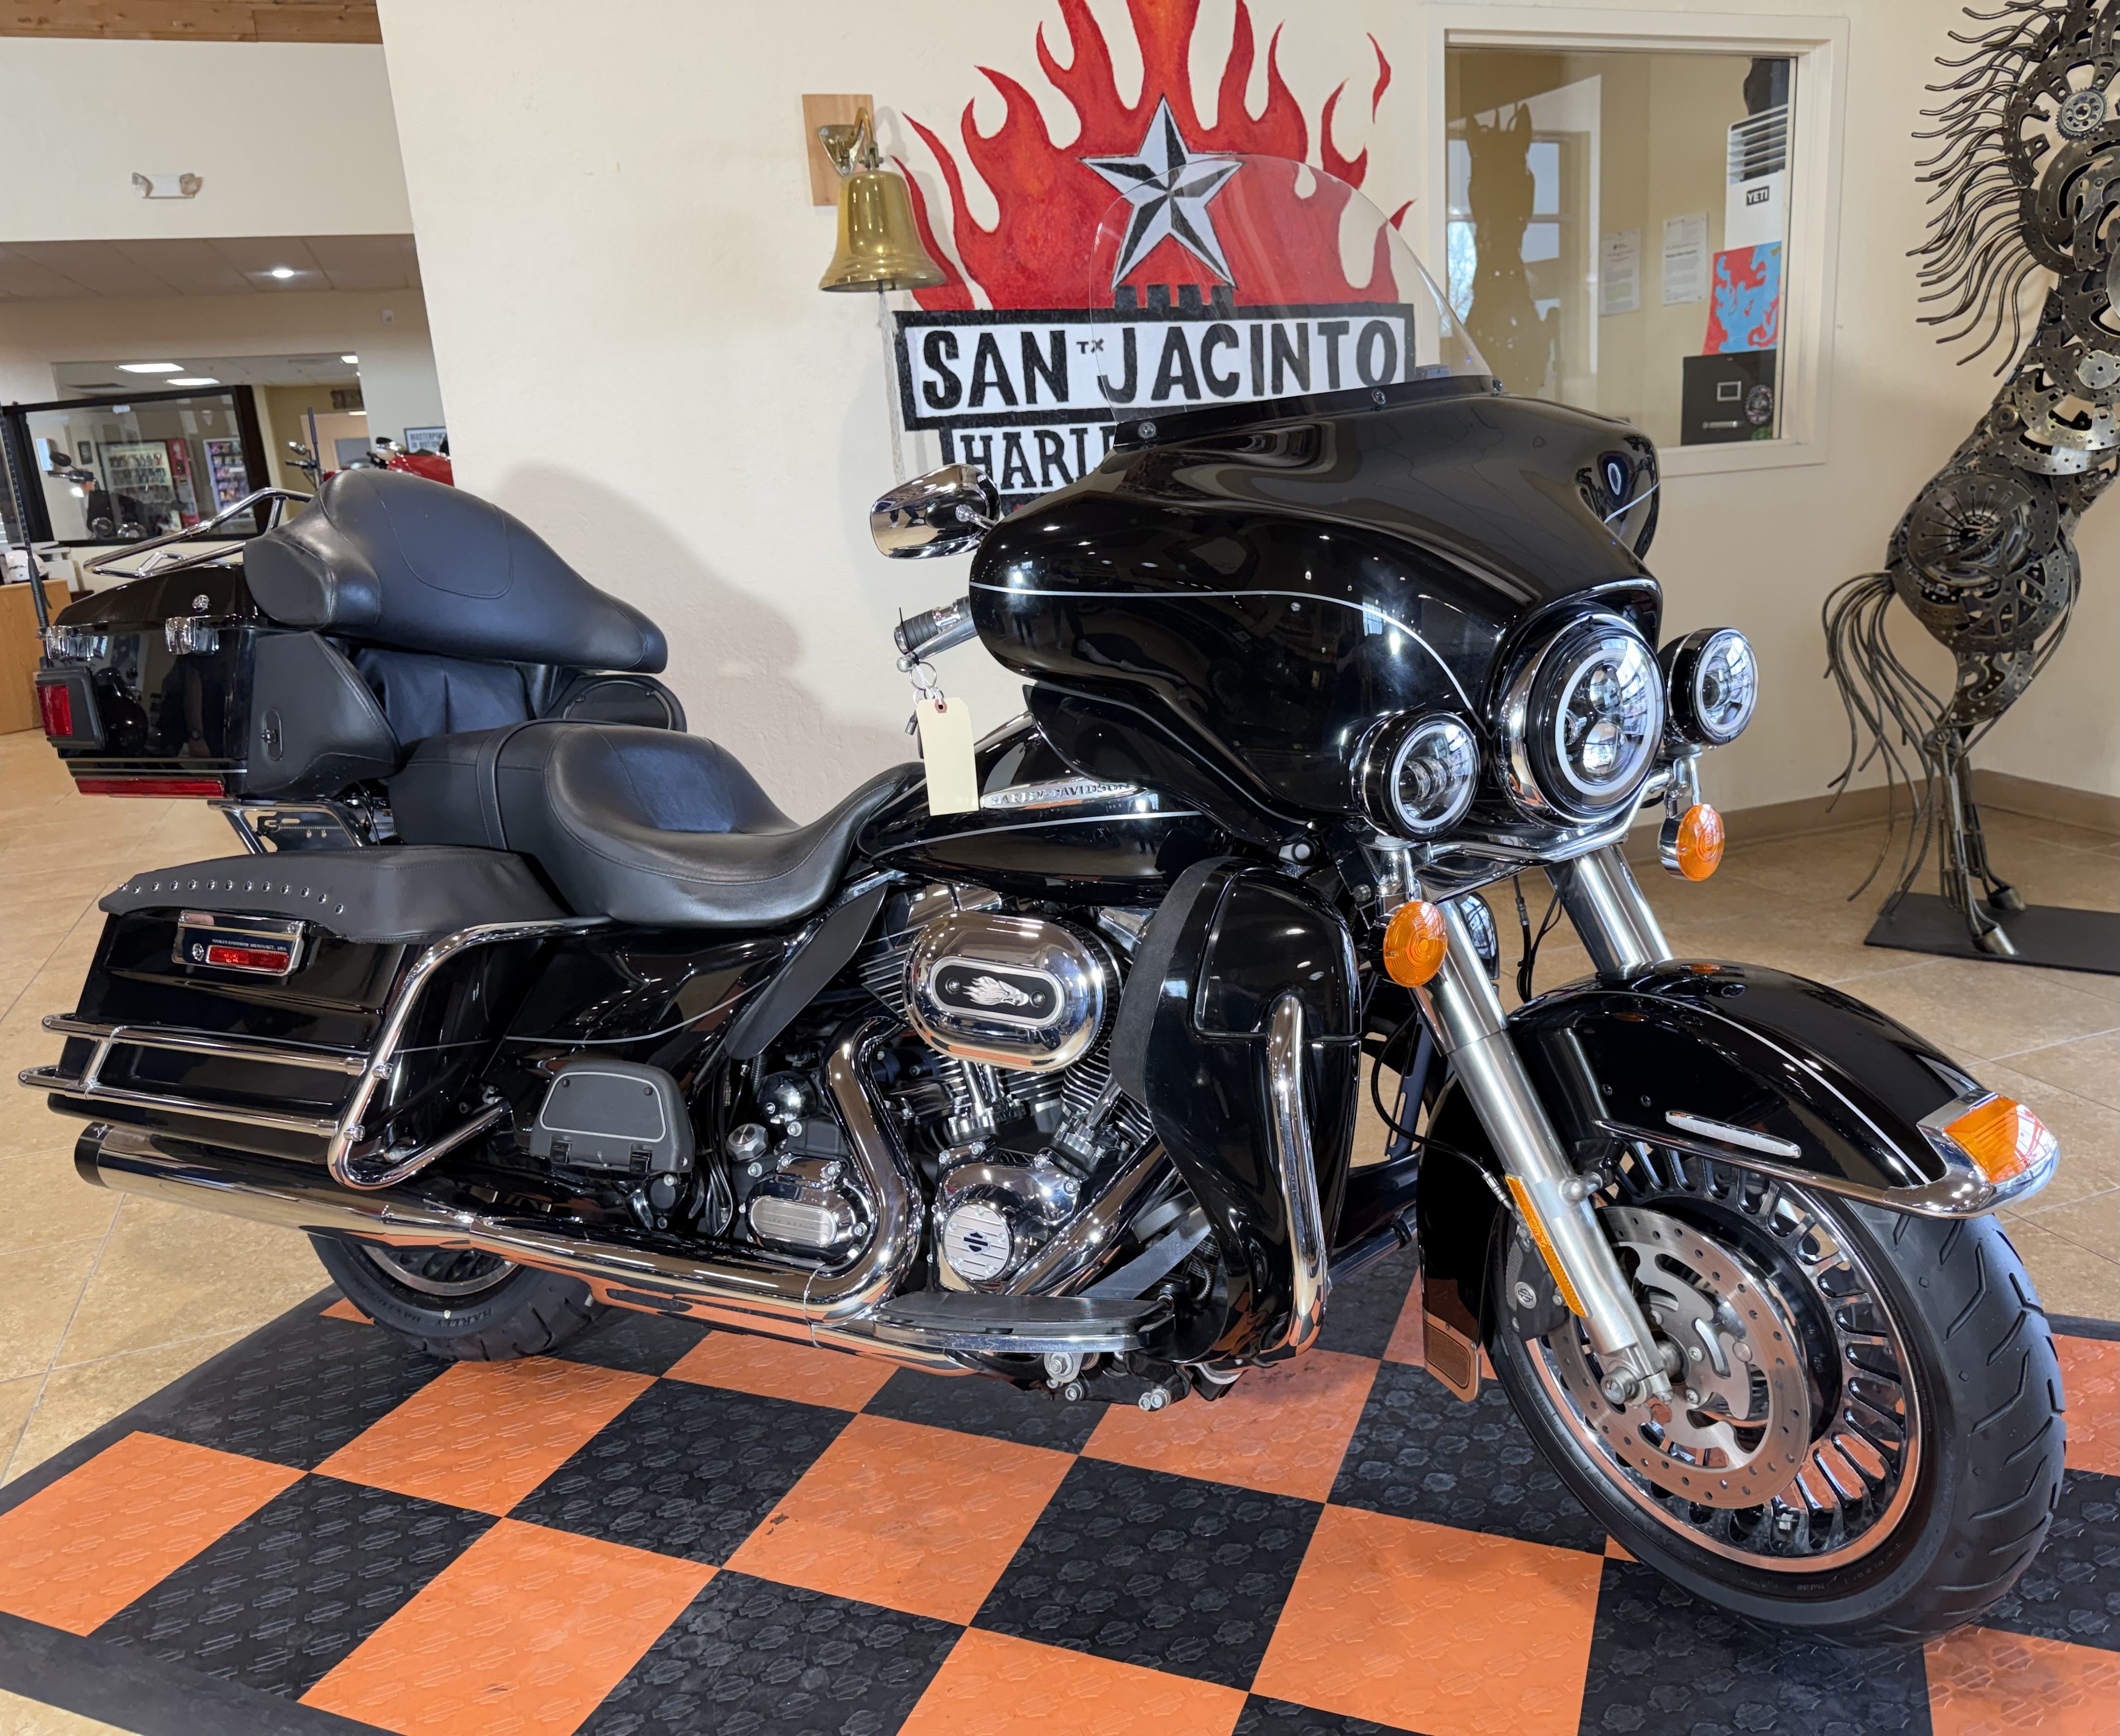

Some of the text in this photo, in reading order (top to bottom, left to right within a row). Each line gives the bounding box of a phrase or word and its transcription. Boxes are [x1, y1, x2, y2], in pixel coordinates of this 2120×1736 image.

[1747, 188, 1768, 203] YETI
[923, 320, 1397, 410] SAN TX JACINTO
[991, 783, 1130, 805] HARLEY-DAVIDSON
